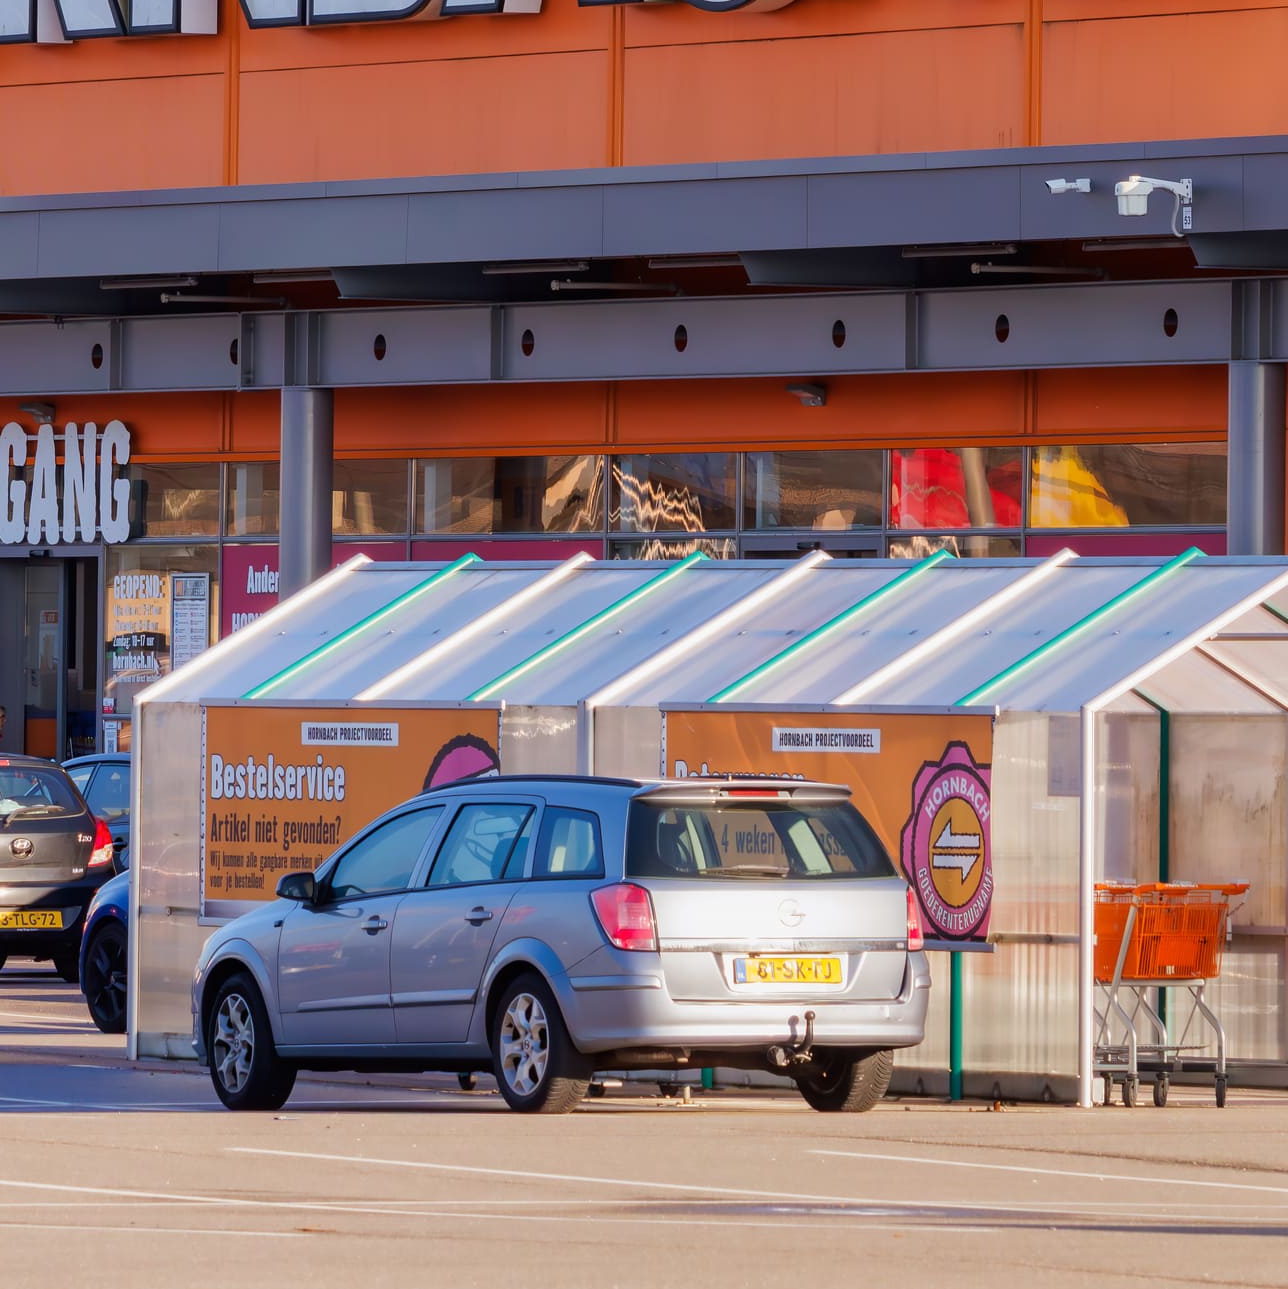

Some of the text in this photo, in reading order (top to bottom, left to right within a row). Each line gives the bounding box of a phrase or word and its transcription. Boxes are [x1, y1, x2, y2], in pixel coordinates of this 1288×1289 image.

[114, 575, 163, 599] GEOPEND:
[307, 727, 392, 741] HORNBACH PROJECTVOORDEEL
[779, 733, 874, 748] HORNBACH PROJECTVOORDEEL
[211, 753, 345, 801] Bestelservice
[924, 776, 990, 823] HORNBACH
[211, 813, 341, 851] Artikel niet gevonden?
[735, 824, 775, 854] weken
[210, 872, 264, 892] voor je bestellen!
[918, 867, 993, 930] GOEDERENTERUGNAME
[1, 913, 56, 927] 3-TLG-72
